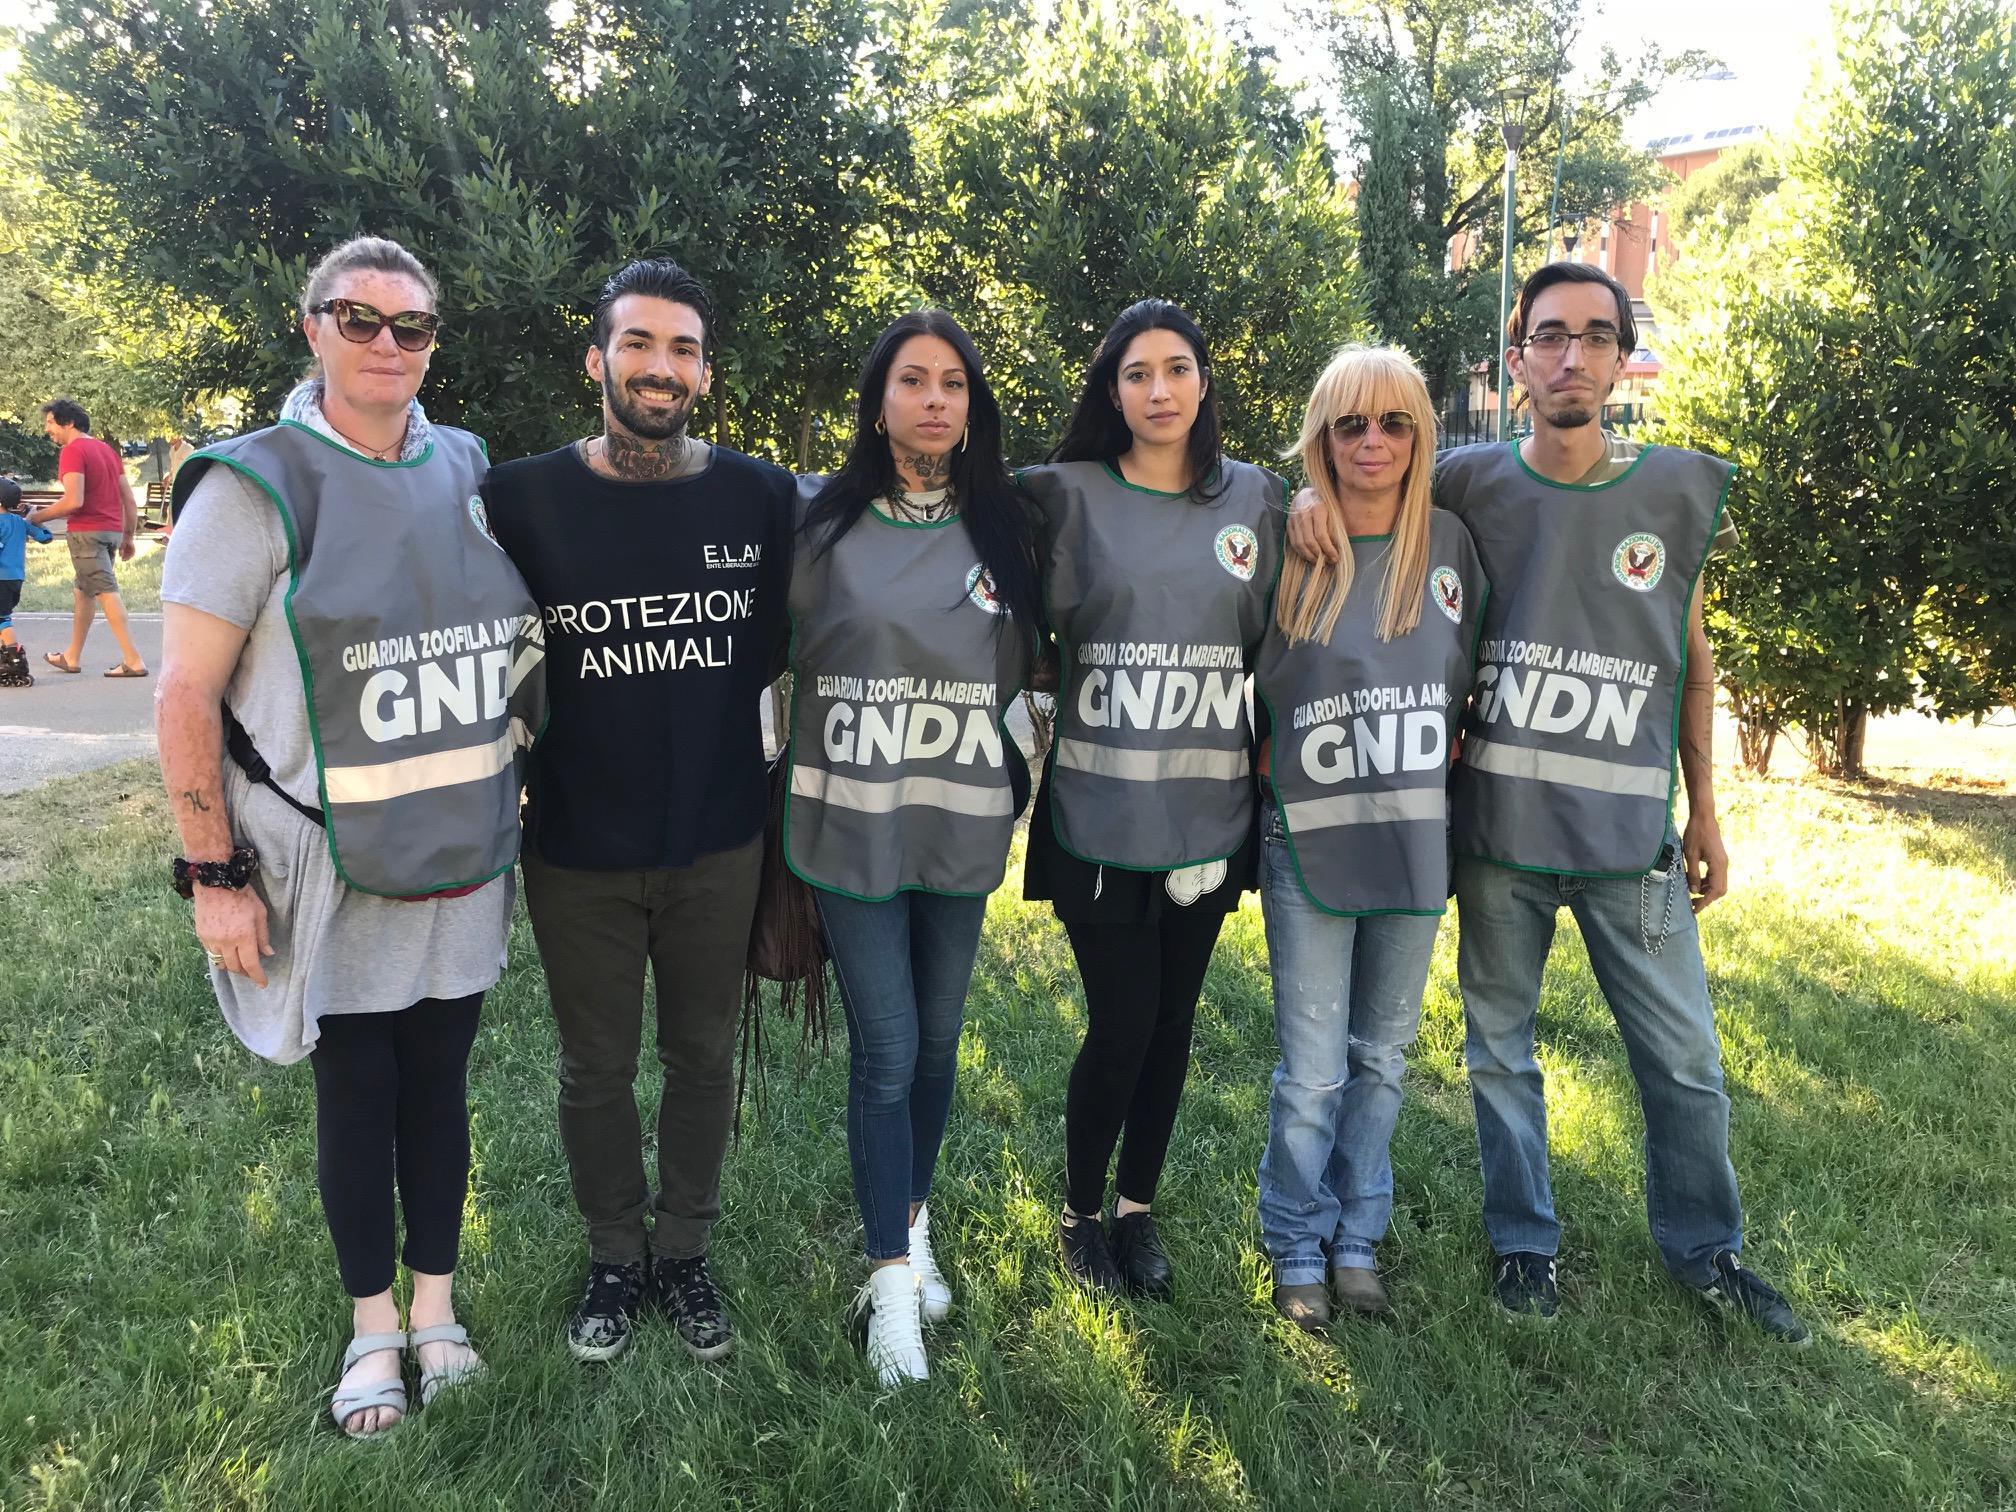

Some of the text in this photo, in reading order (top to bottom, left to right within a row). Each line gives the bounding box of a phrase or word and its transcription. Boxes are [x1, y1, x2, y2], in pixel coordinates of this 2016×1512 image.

[1619, 535, 1656, 551] NAZIONALI
[1614, 551, 1629, 583] GUARDIE
[545, 587, 756, 634] PROTEZIONE
[342, 634, 418, 672] GUARDIA
[419, 622, 492, 659] ZOOFILA
[580, 635, 732, 679] ANIMALI
[1078, 643, 1116, 666] GUARDIA
[1118, 642, 1179, 667] ZOOFILA
[1506, 640, 1563, 671] ZOOFILA
[1564, 649, 1658, 688] AMBIENTALE
[816, 675, 863, 702] GUARDIA
[866, 676, 927, 703] ZOOFILA
[1078, 668, 1245, 730] GNDN
[1293, 692, 1353, 730] GUARDIA
[1353, 685, 1417, 714] ZOOFILA
[1476, 664, 1648, 747] GNDN
[823, 701, 1004, 768] GNDN
[1300, 710, 1447, 785] GND
